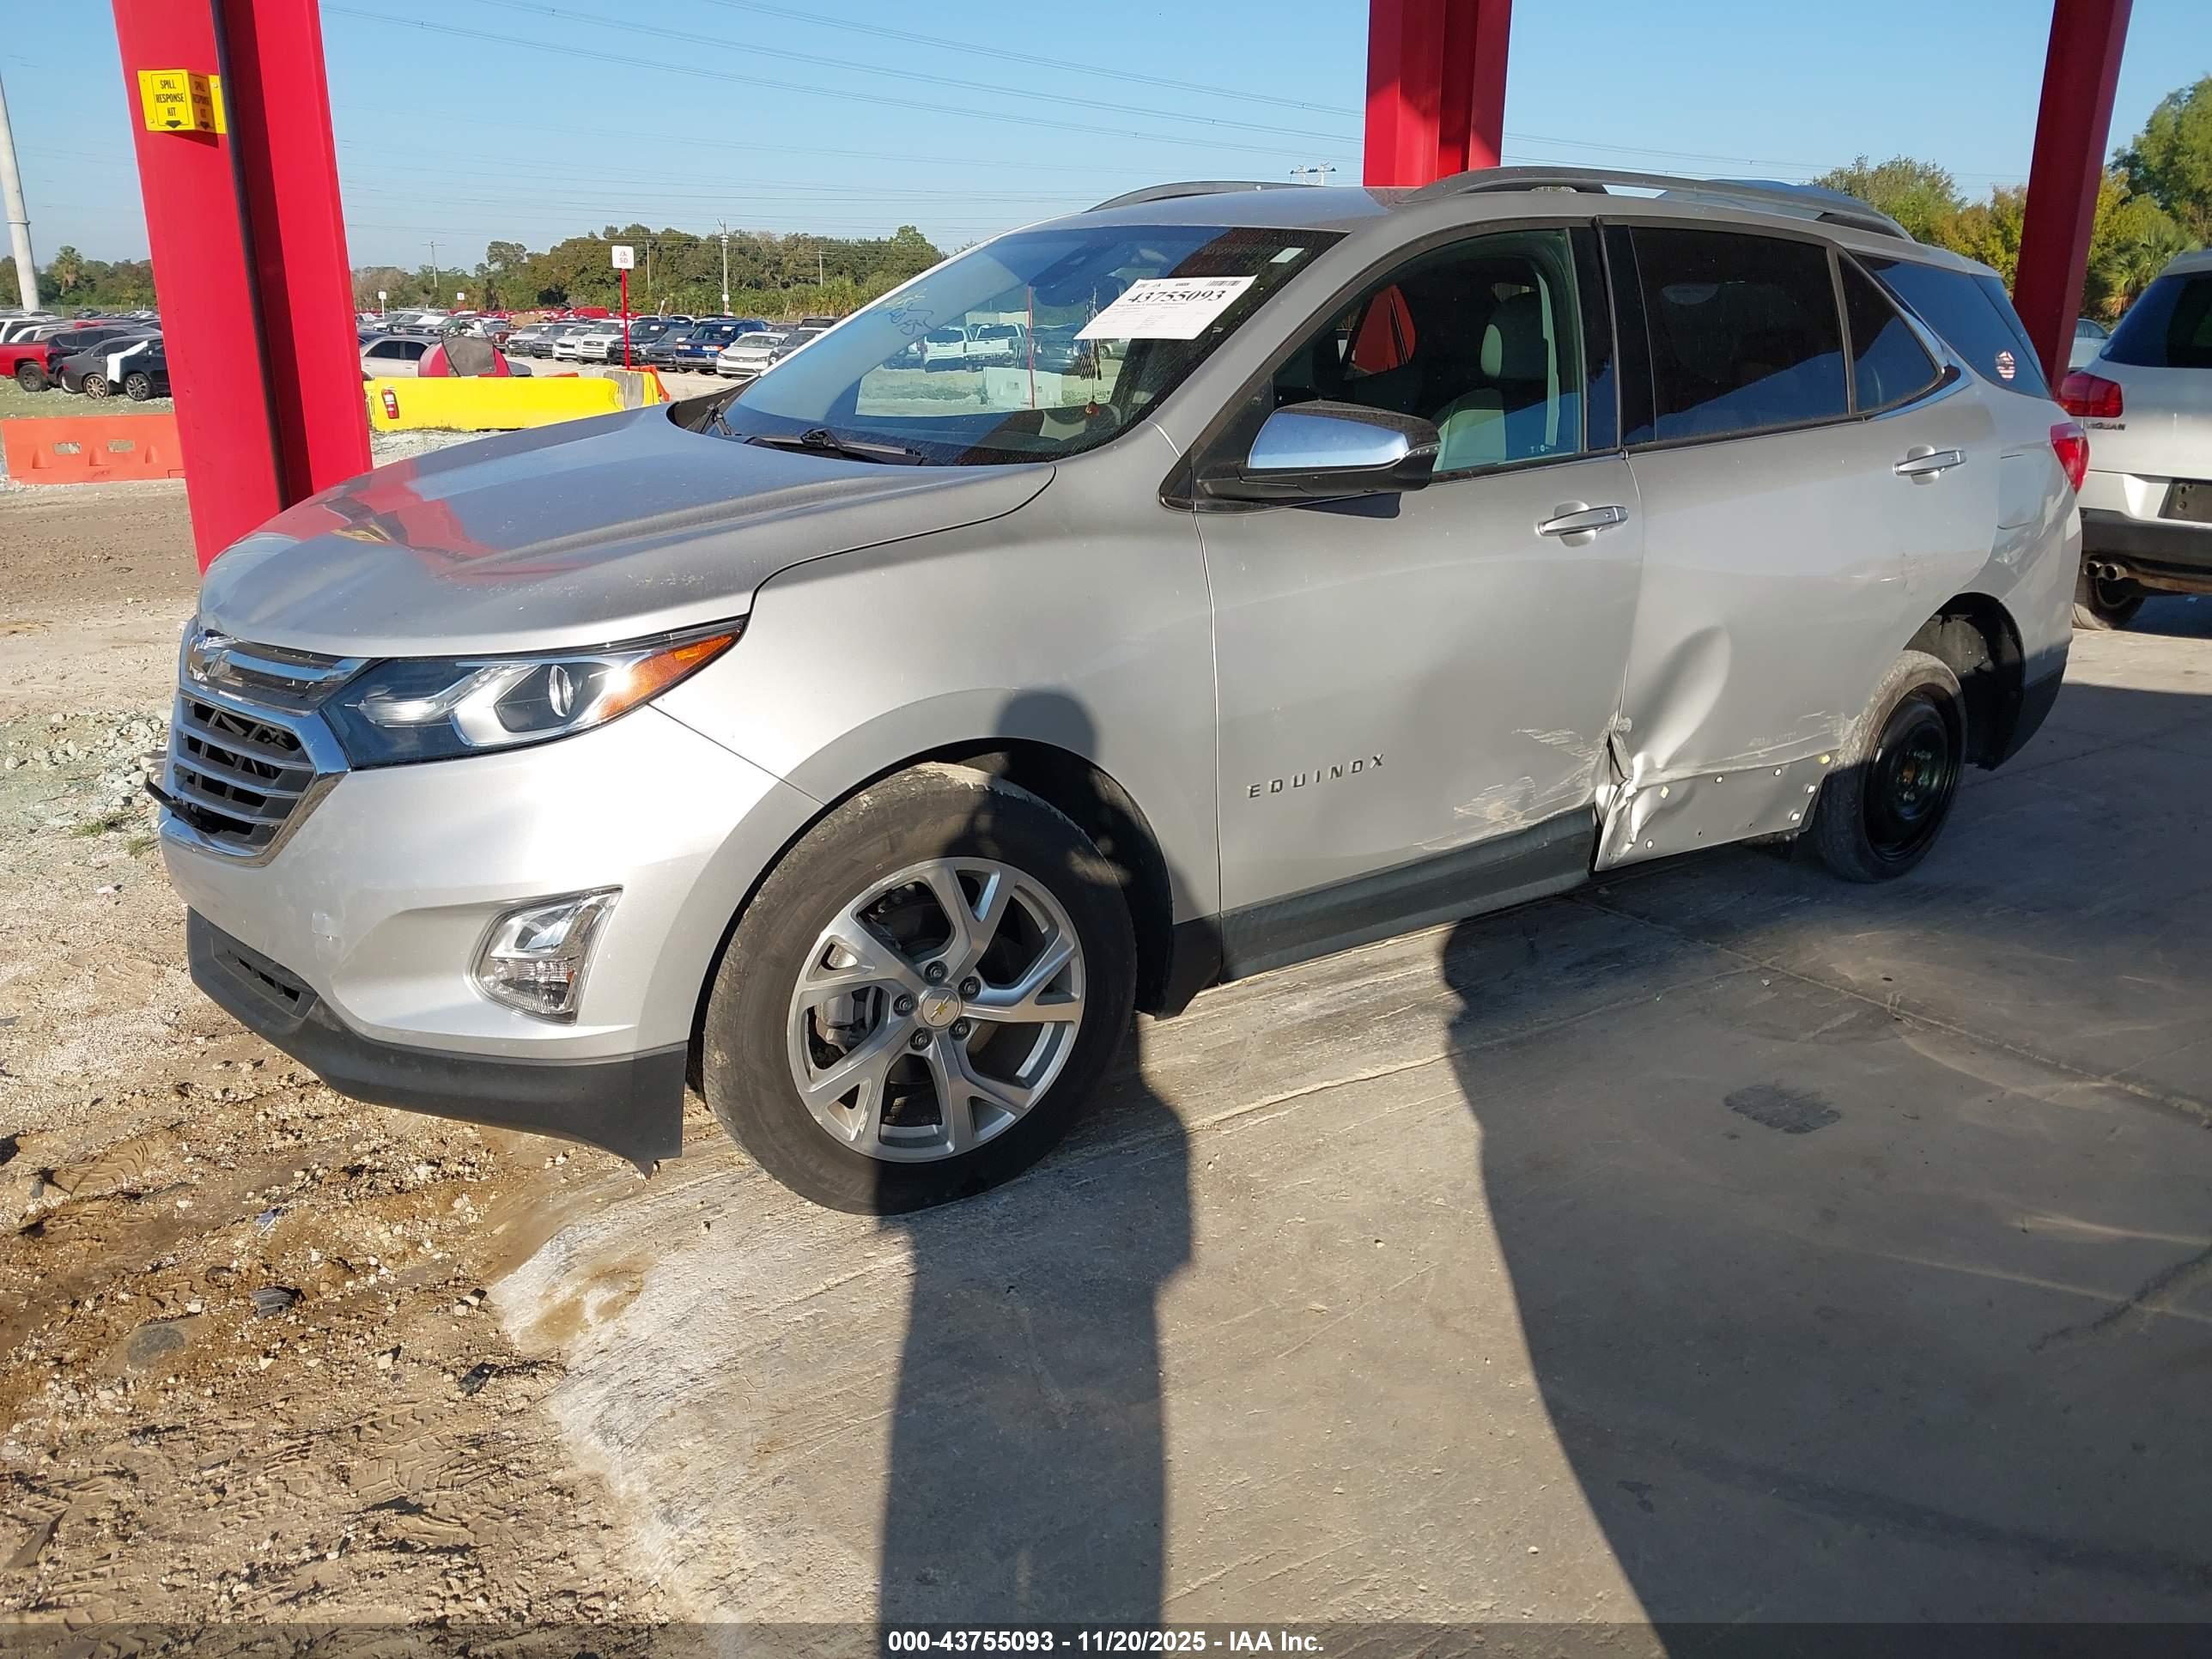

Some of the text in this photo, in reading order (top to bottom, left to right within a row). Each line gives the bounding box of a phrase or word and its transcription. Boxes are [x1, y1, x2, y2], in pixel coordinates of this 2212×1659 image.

[160, 79, 177, 89] SPILL
[155, 93, 185, 103] RESPONSE
[167, 106, 177, 117] KIT
[1127, 290, 1226, 303] 43755093
[1248, 753, 1384, 799] EQUINOX
